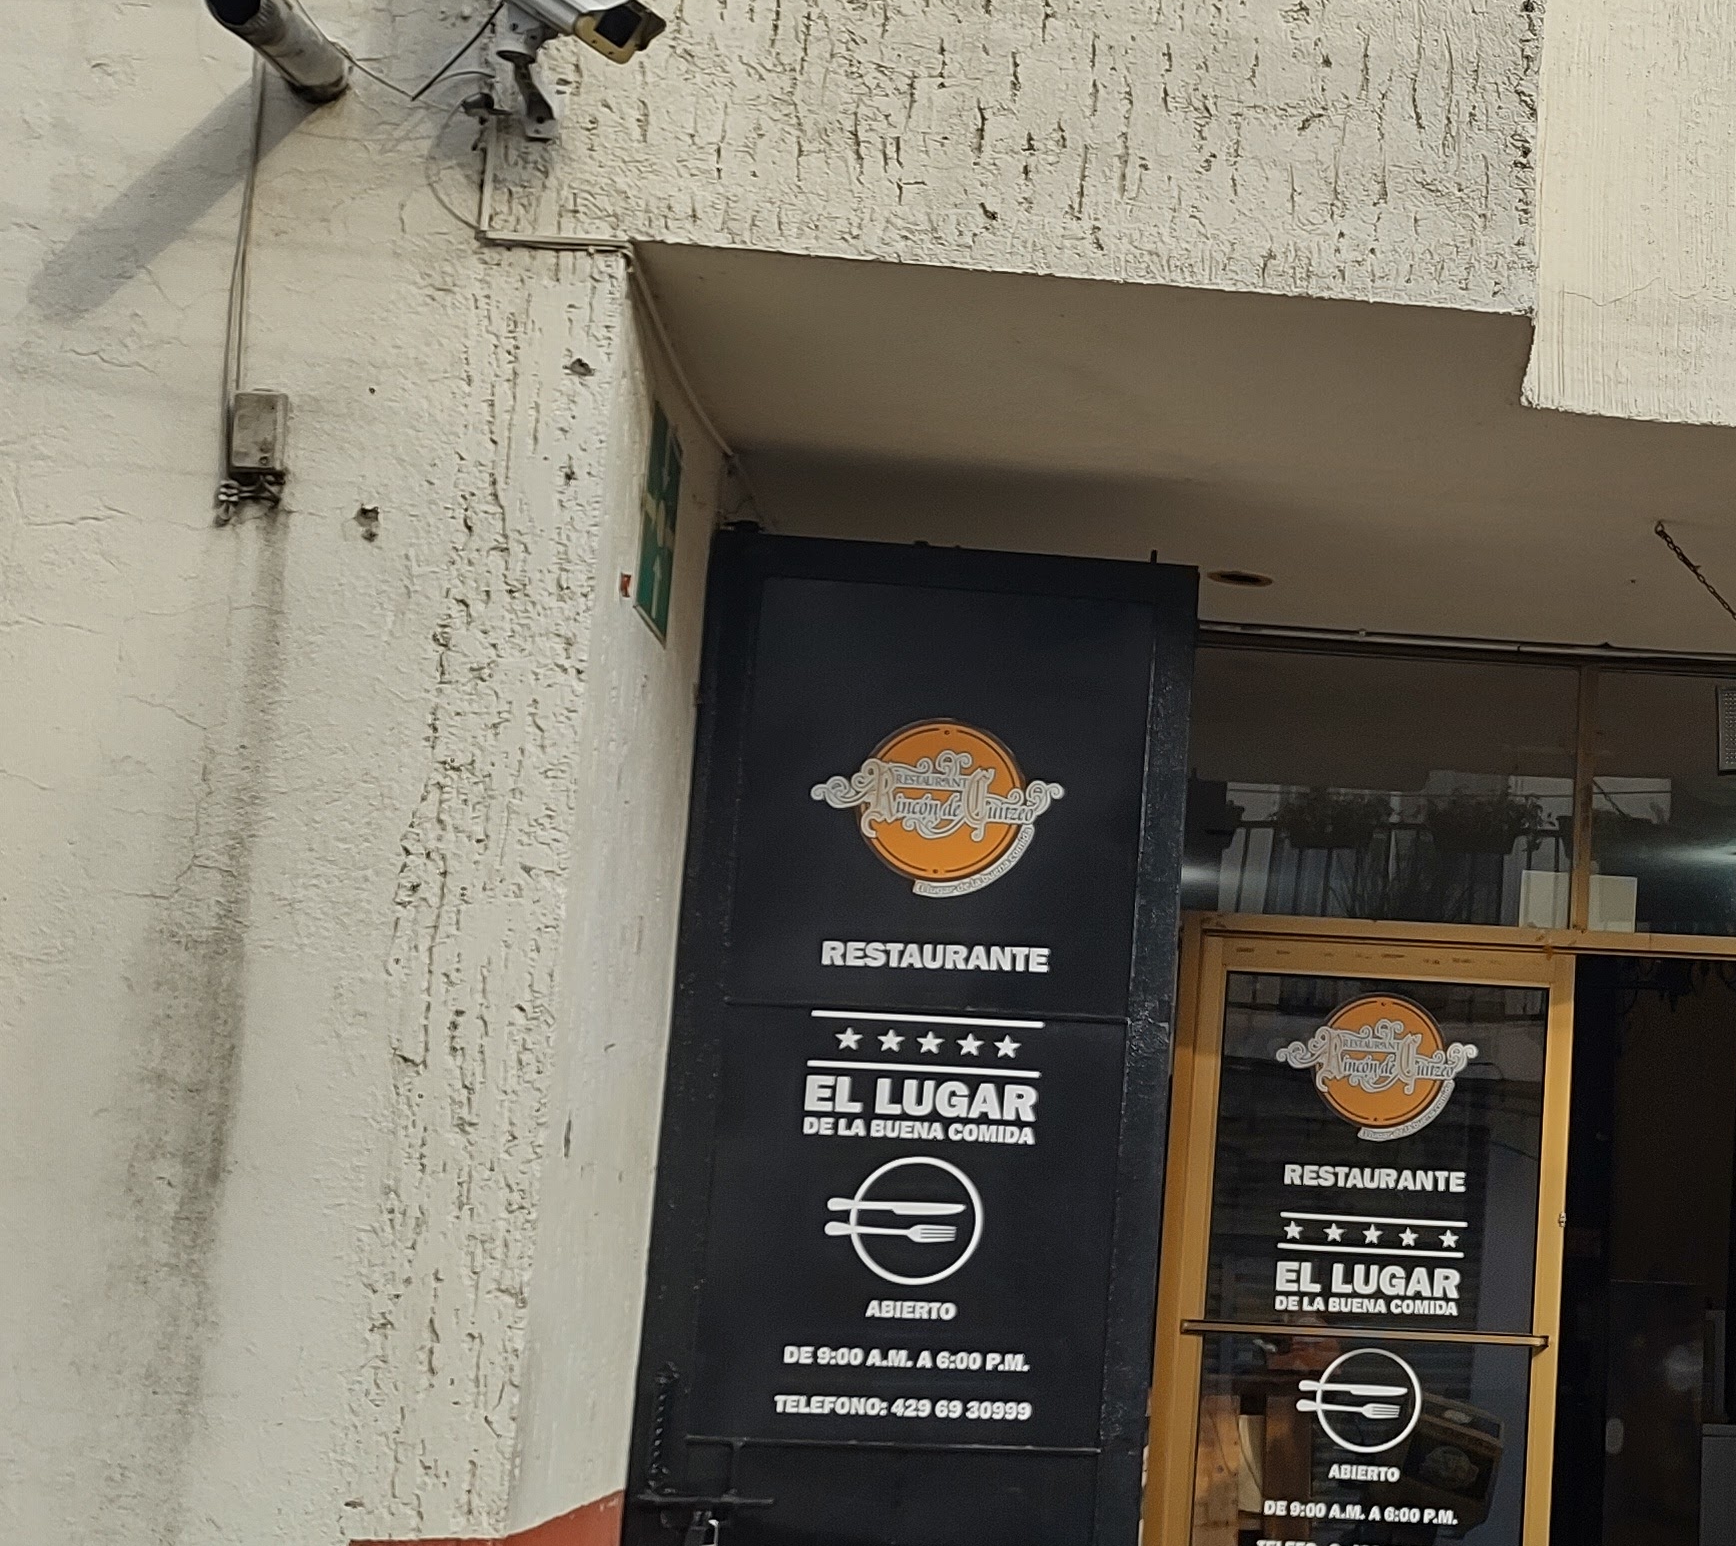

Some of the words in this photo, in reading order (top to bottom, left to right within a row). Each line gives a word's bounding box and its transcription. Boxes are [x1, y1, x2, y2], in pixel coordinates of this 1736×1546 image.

[822, 941, 1049, 973] RESTAURANTE
[804, 1075, 863, 1113] EL
[875, 1078, 1038, 1122] LUGAR
[803, 1117, 834, 1136] DE
[838, 1118, 866, 1137] LA
[870, 1120, 944, 1141] BUENA
[949, 1124, 1035, 1145] COMIDA
[1284, 1165, 1466, 1192] RESTAURANTE
[1275, 1261, 1322, 1293] EL
[1331, 1263, 1461, 1299] LUGAR
[866, 1300, 957, 1321] ABIERTO
[1275, 1296, 1298, 1311] DE
[1302, 1297, 1325, 1312] LA
[1328, 1298, 1387, 1314] BUENA
[1390, 1300, 1458, 1316] COMIDA
[784, 1346, 815, 1365] DE
[817, 1347, 861, 1366] 9:00
[866, 1349, 913, 1369] A.M.
[916, 1351, 933, 1369] A
[936, 1351, 982, 1370] 6:00
[986, 1353, 1030, 1372] P.M.
[775, 1394, 889, 1416] TELEFONO:
[891, 1397, 931, 1417] 429
[935, 1399, 963, 1419] 69
[966, 1400, 1032, 1421] 30999
[1328, 1464, 1400, 1482] ABIERTO
[1264, 1500, 1287, 1517] DE
[1290, 1501, 1327, 1519] 9:00
[1329, 1504, 1365, 1521] A.M.
[1368, 1506, 1381, 1521] A
[1384, 1507, 1421, 1523] 6:00
[1423, 1509, 1458, 1525] P.M.
